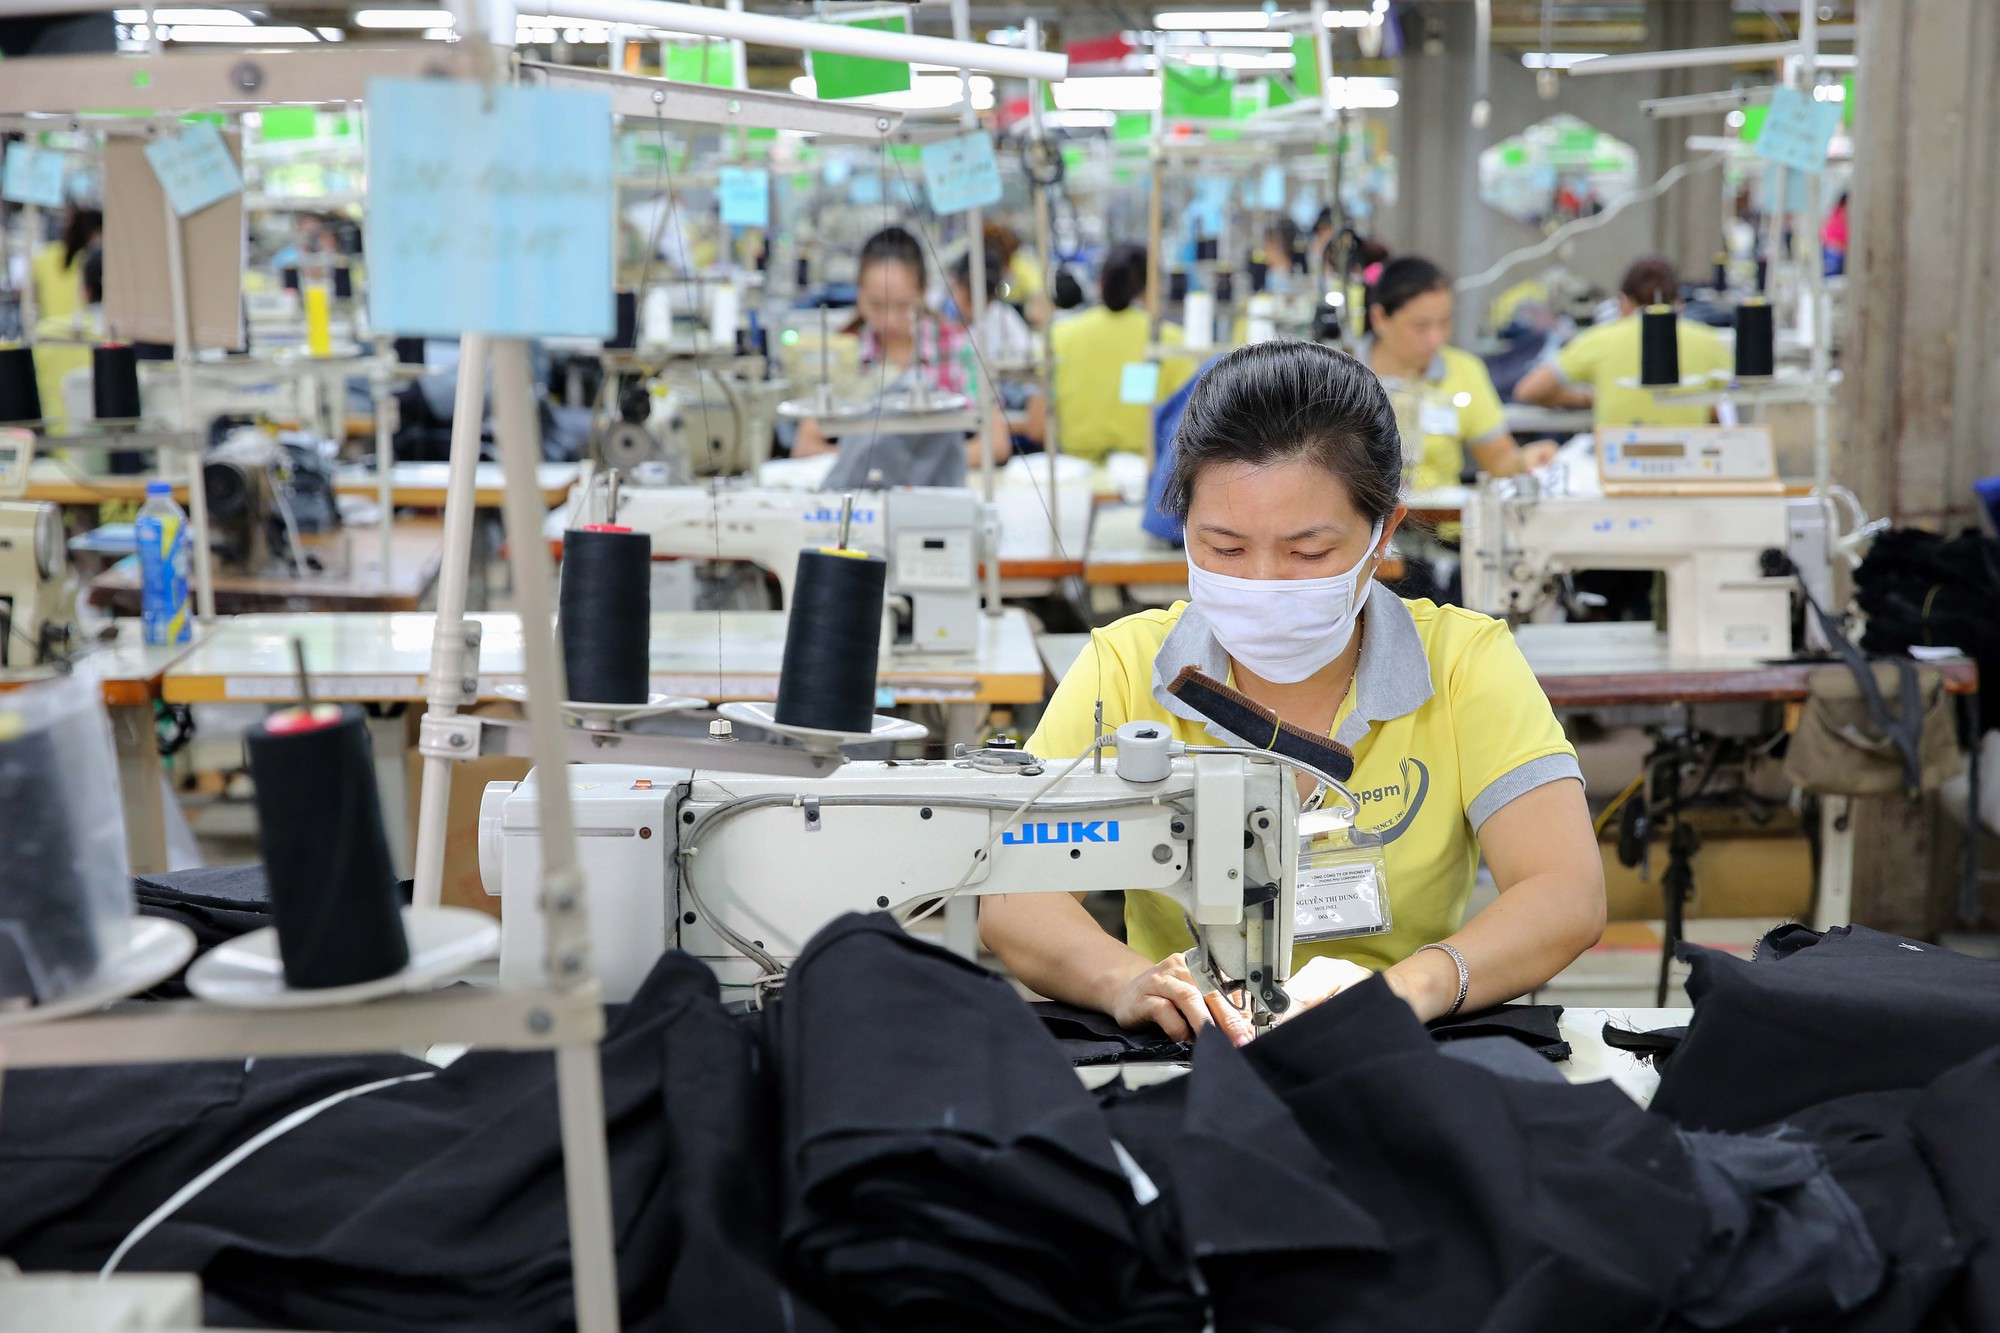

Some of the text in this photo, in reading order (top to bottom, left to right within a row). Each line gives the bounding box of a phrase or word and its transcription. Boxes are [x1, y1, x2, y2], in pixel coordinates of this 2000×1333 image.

[1373, 818, 1395, 831] SINCE
[1002, 820, 1119, 845] JUKI
[1324, 895, 1337, 903] THỊ
[1338, 893, 1358, 901] DUNG
